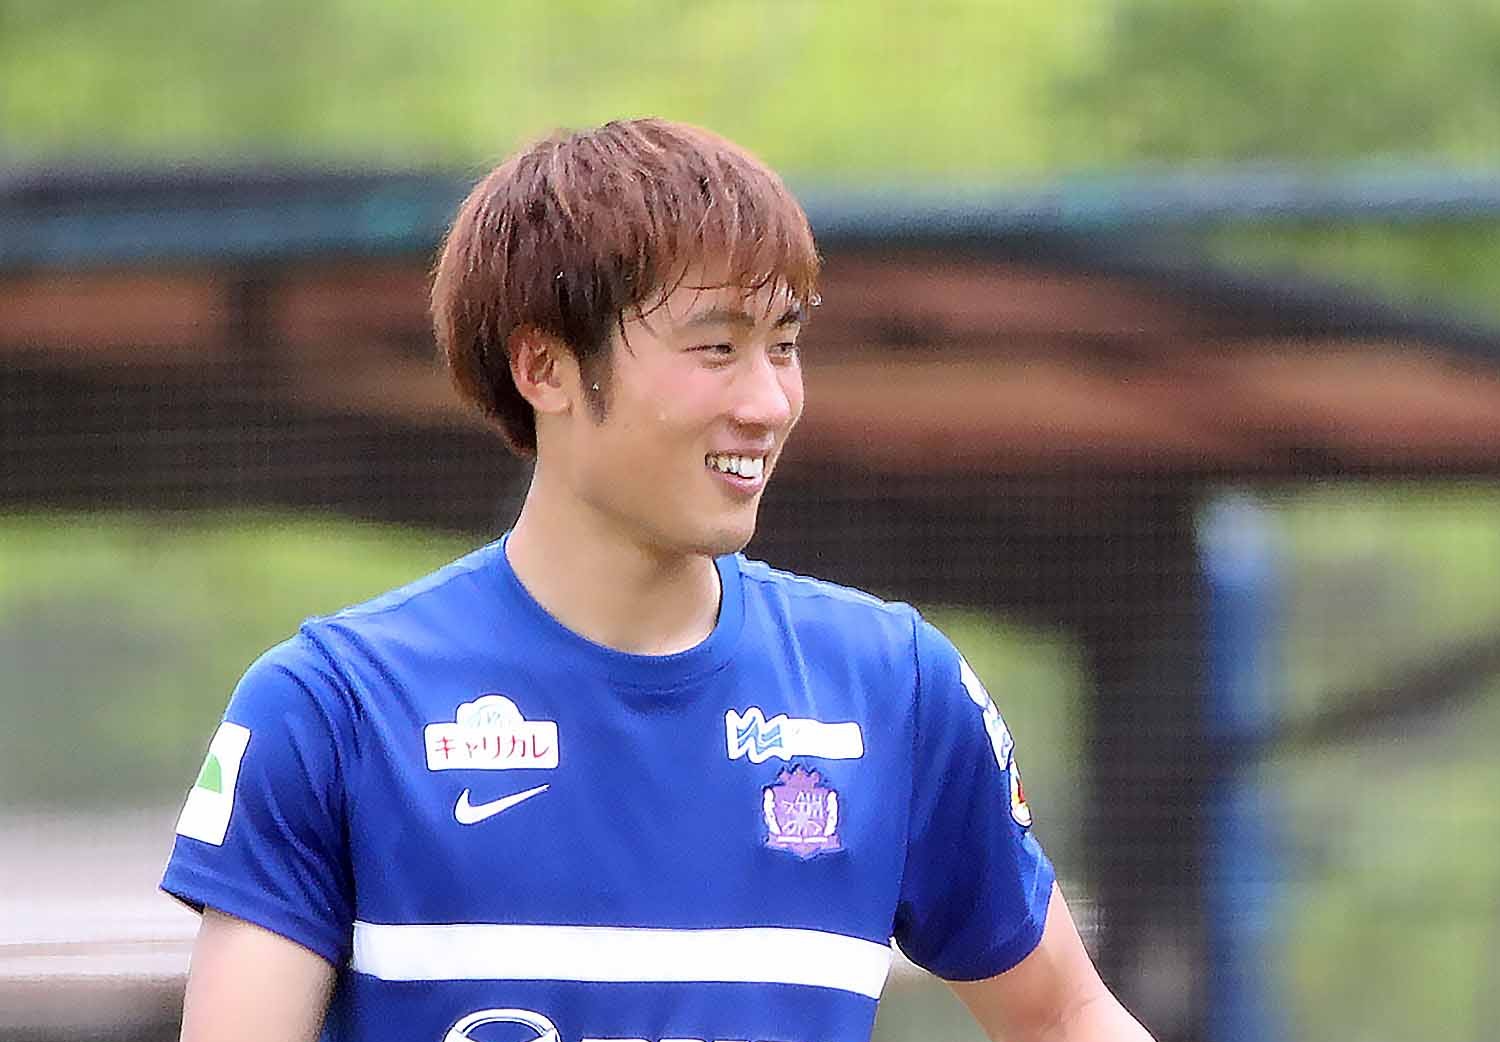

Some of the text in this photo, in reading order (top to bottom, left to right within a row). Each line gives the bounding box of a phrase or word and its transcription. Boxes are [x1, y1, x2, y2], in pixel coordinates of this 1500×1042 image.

[434, 734, 550, 760] キャリカレ
